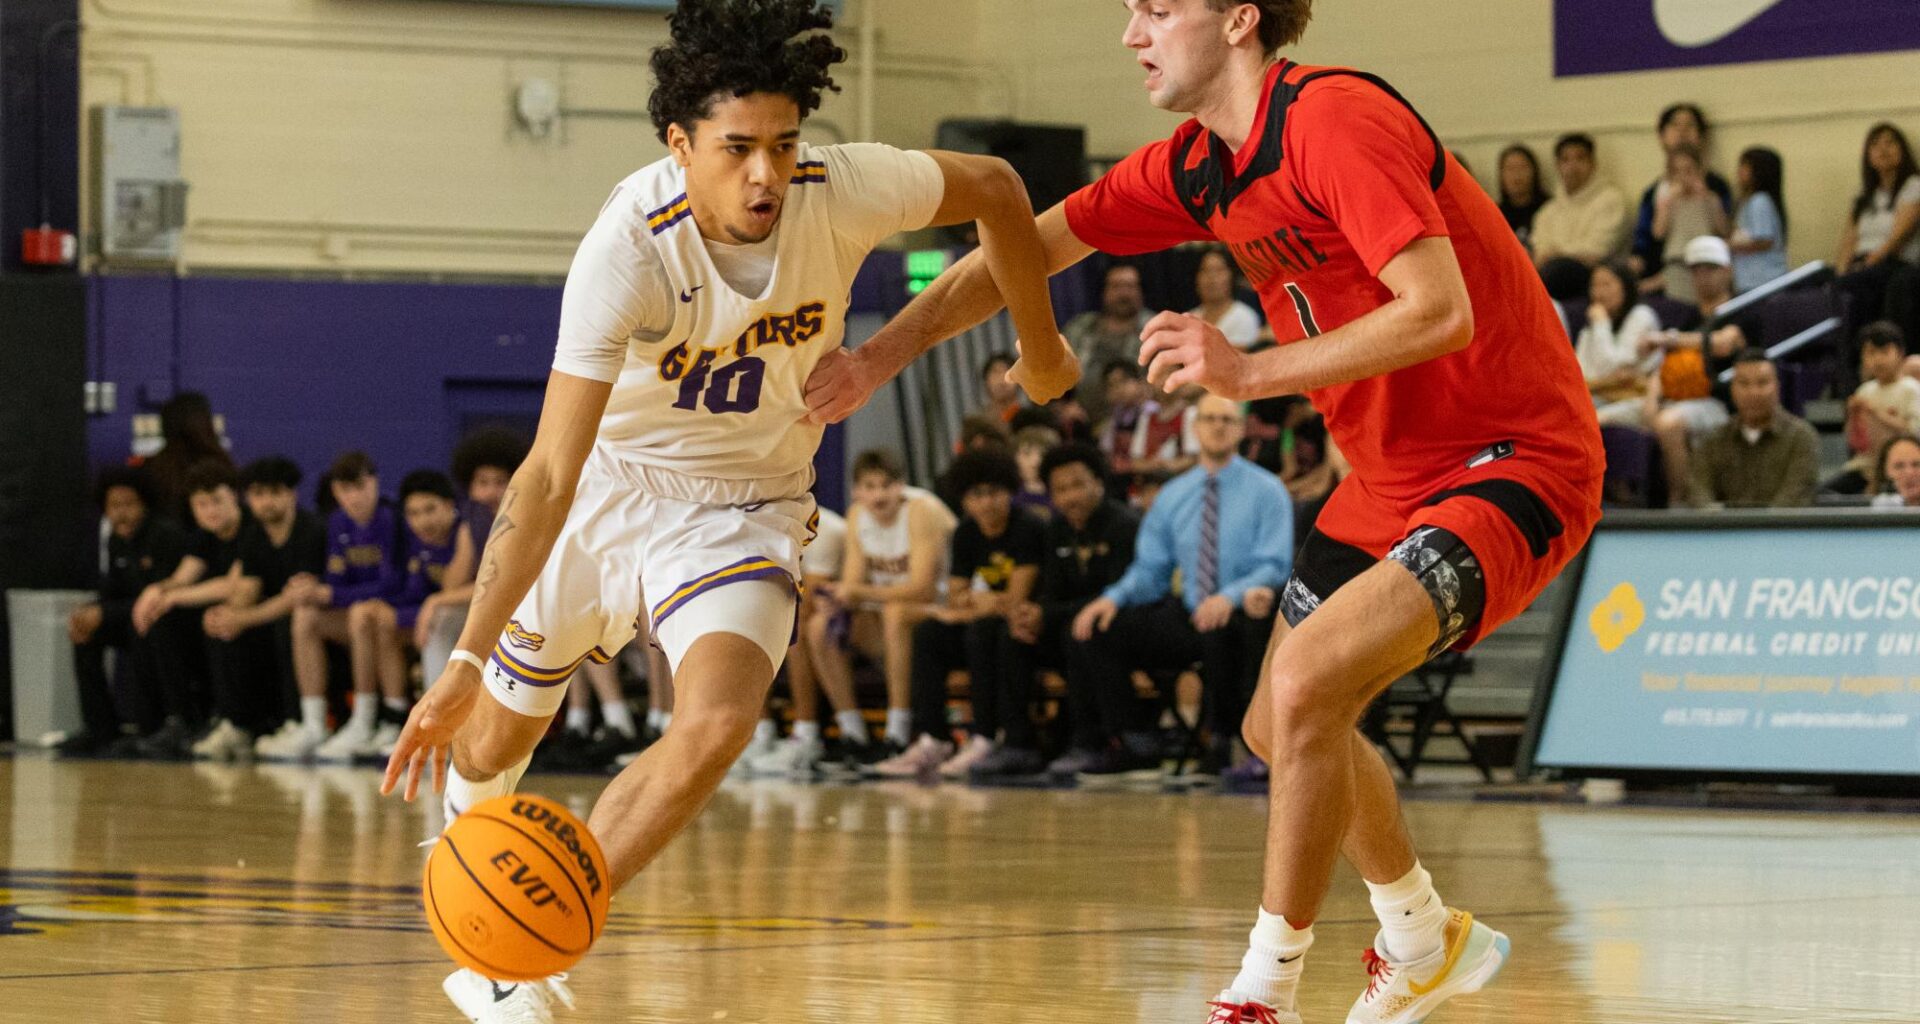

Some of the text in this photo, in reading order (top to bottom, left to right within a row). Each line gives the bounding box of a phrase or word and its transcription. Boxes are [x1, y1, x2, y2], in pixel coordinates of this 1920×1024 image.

[672, 357, 766, 414] 10
[1656, 576, 1920, 621] SAN FRANCIS
[1645, 632, 1757, 656] FEDERAL
[1770, 632, 1869, 656] CREDIT
[491, 849, 557, 907] EVO
